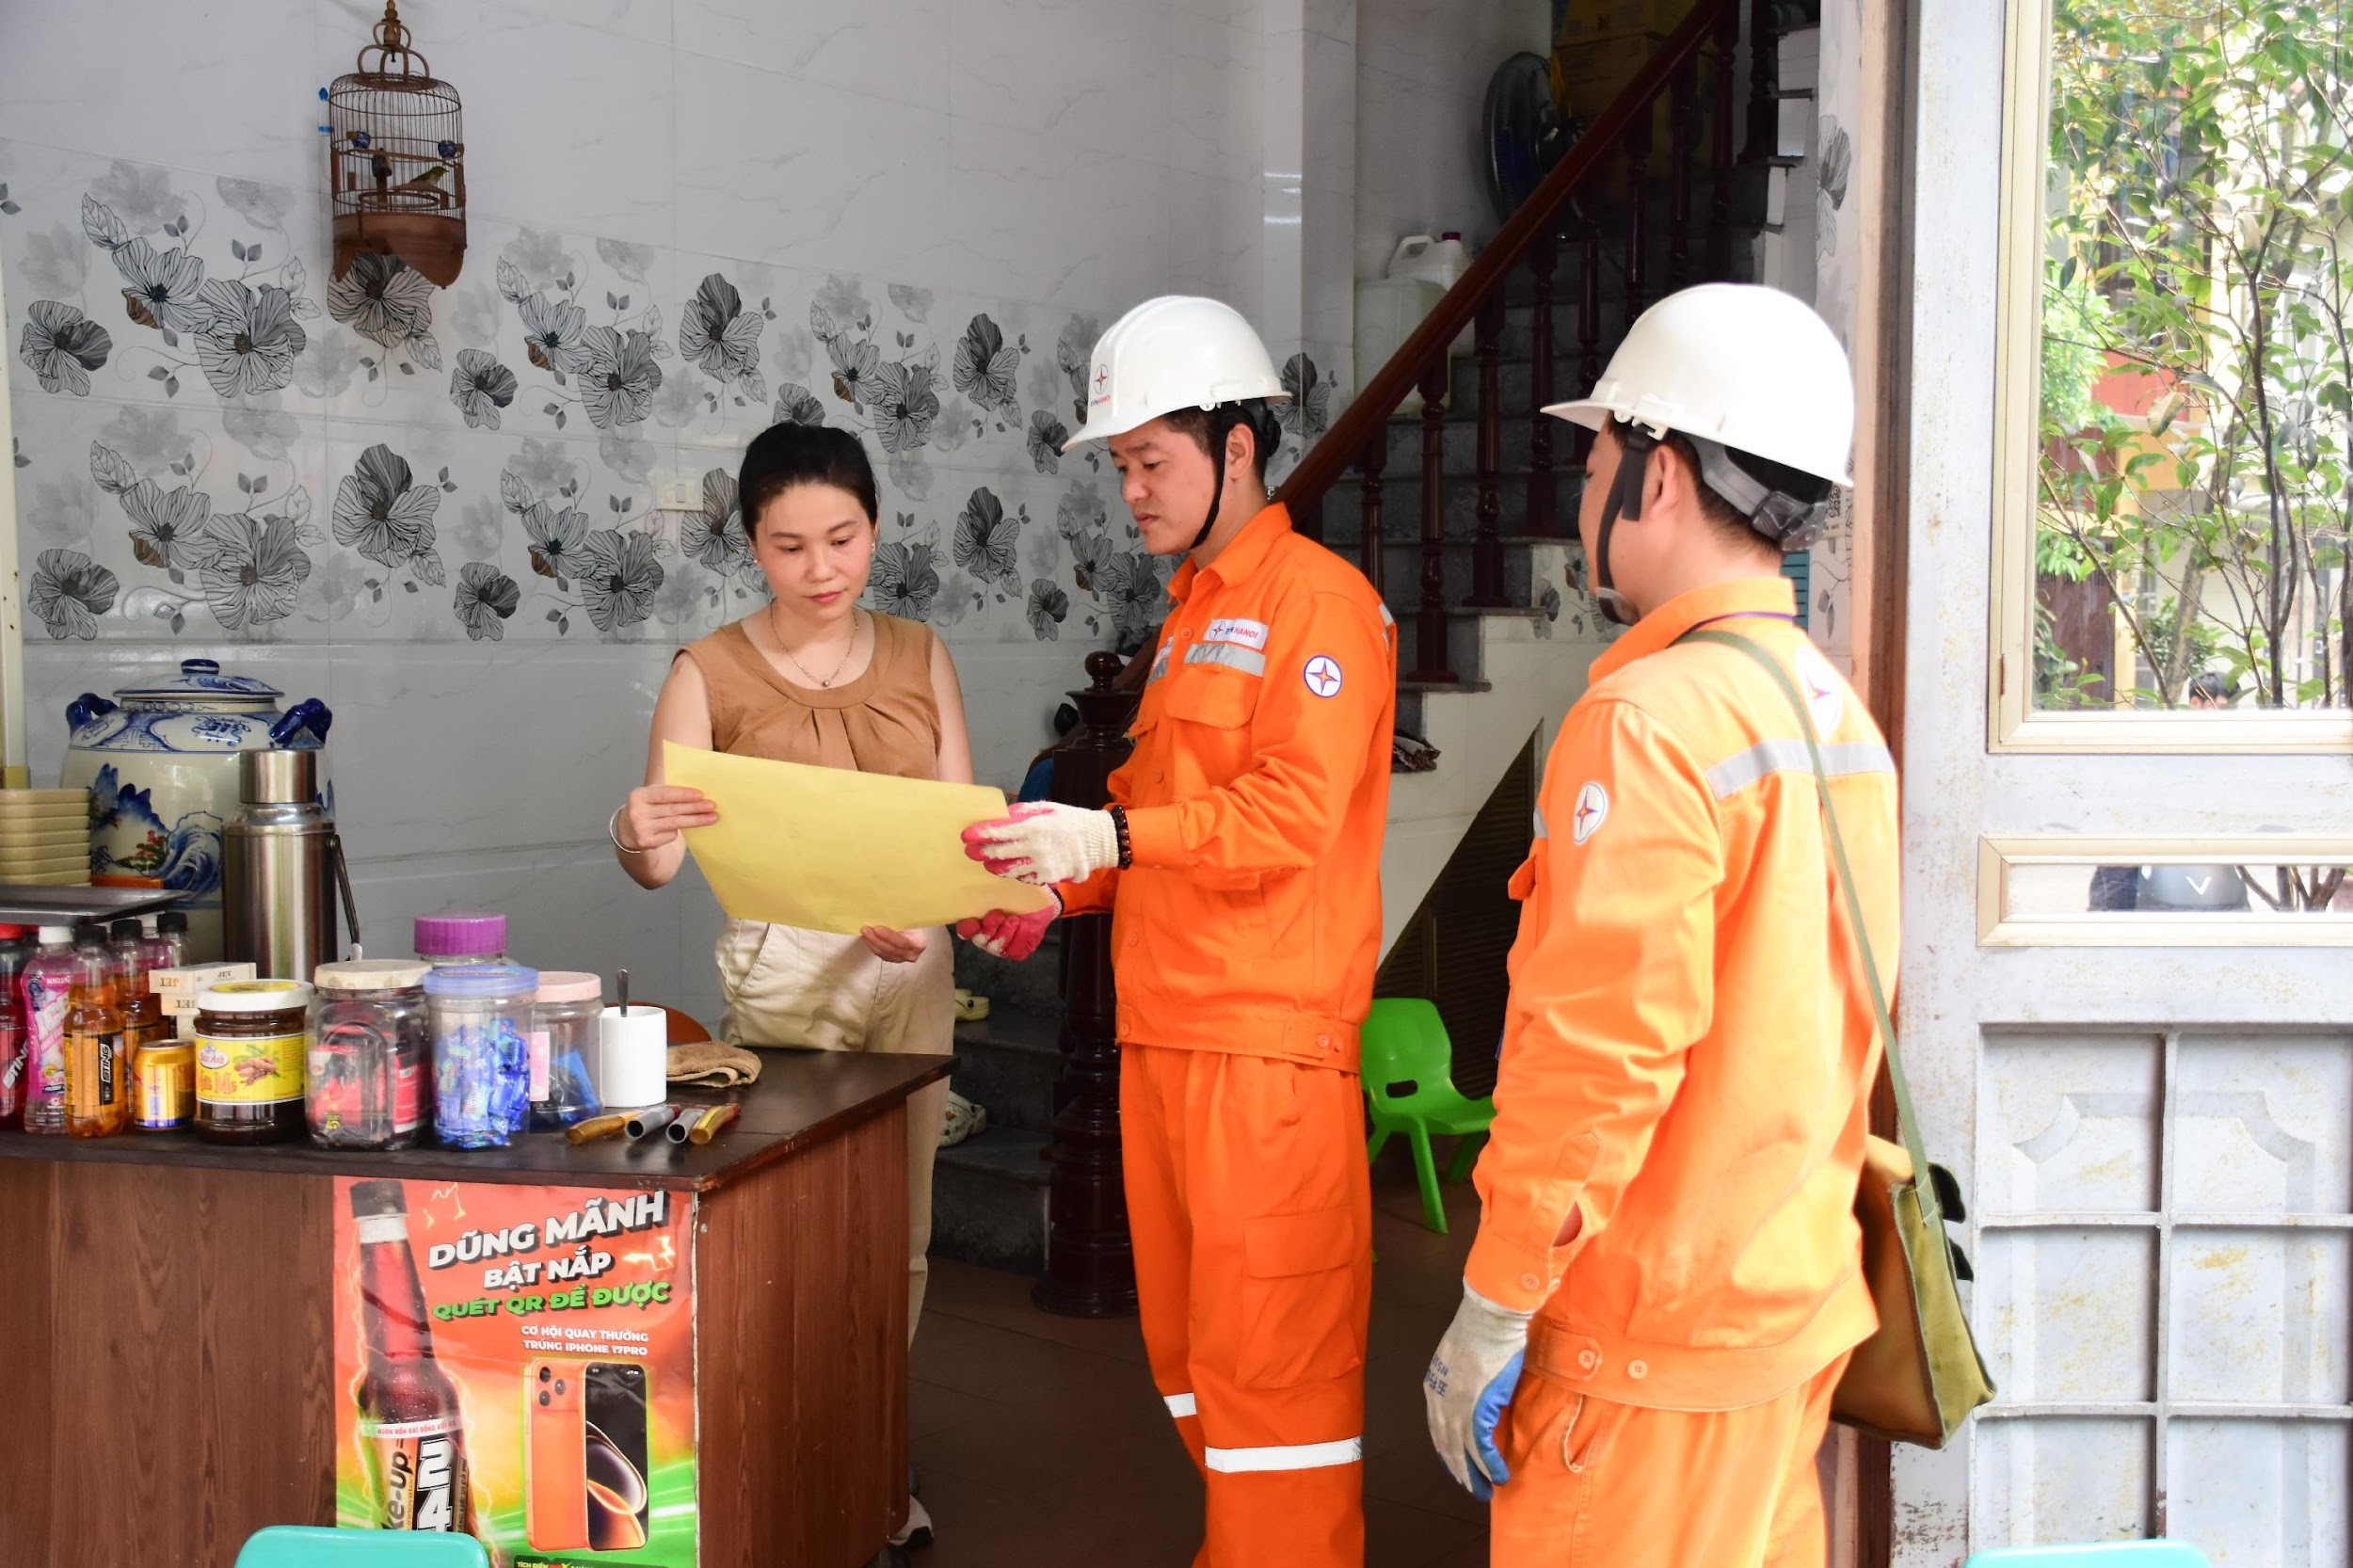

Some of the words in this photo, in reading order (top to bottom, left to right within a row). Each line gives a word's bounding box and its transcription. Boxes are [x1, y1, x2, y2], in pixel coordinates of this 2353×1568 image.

[100, 1044, 113, 1083] STING
[428, 1223, 538, 1270] DŨNG
[545, 1191, 667, 1245] MÃNH
[484, 1260, 542, 1290] BẬT
[548, 1245, 613, 1281] NẮP
[433, 1298, 501, 1320] QUÉT
[505, 1295, 544, 1316] QR
[549, 1283, 586, 1309] ĐỂ
[592, 1280, 671, 1310] ĐƯỢC
[521, 1324, 537, 1336] CƠ
[541, 1324, 562, 1338] HỘI
[565, 1328, 597, 1339] QUAY
[600, 1328, 649, 1342] THƯỞNG
[523, 1337, 563, 1351] TRÚNG
[566, 1342, 609, 1353] IPHONE
[612, 1345, 648, 1355] 17PRO
[381, 1451, 414, 1529] ke-up
